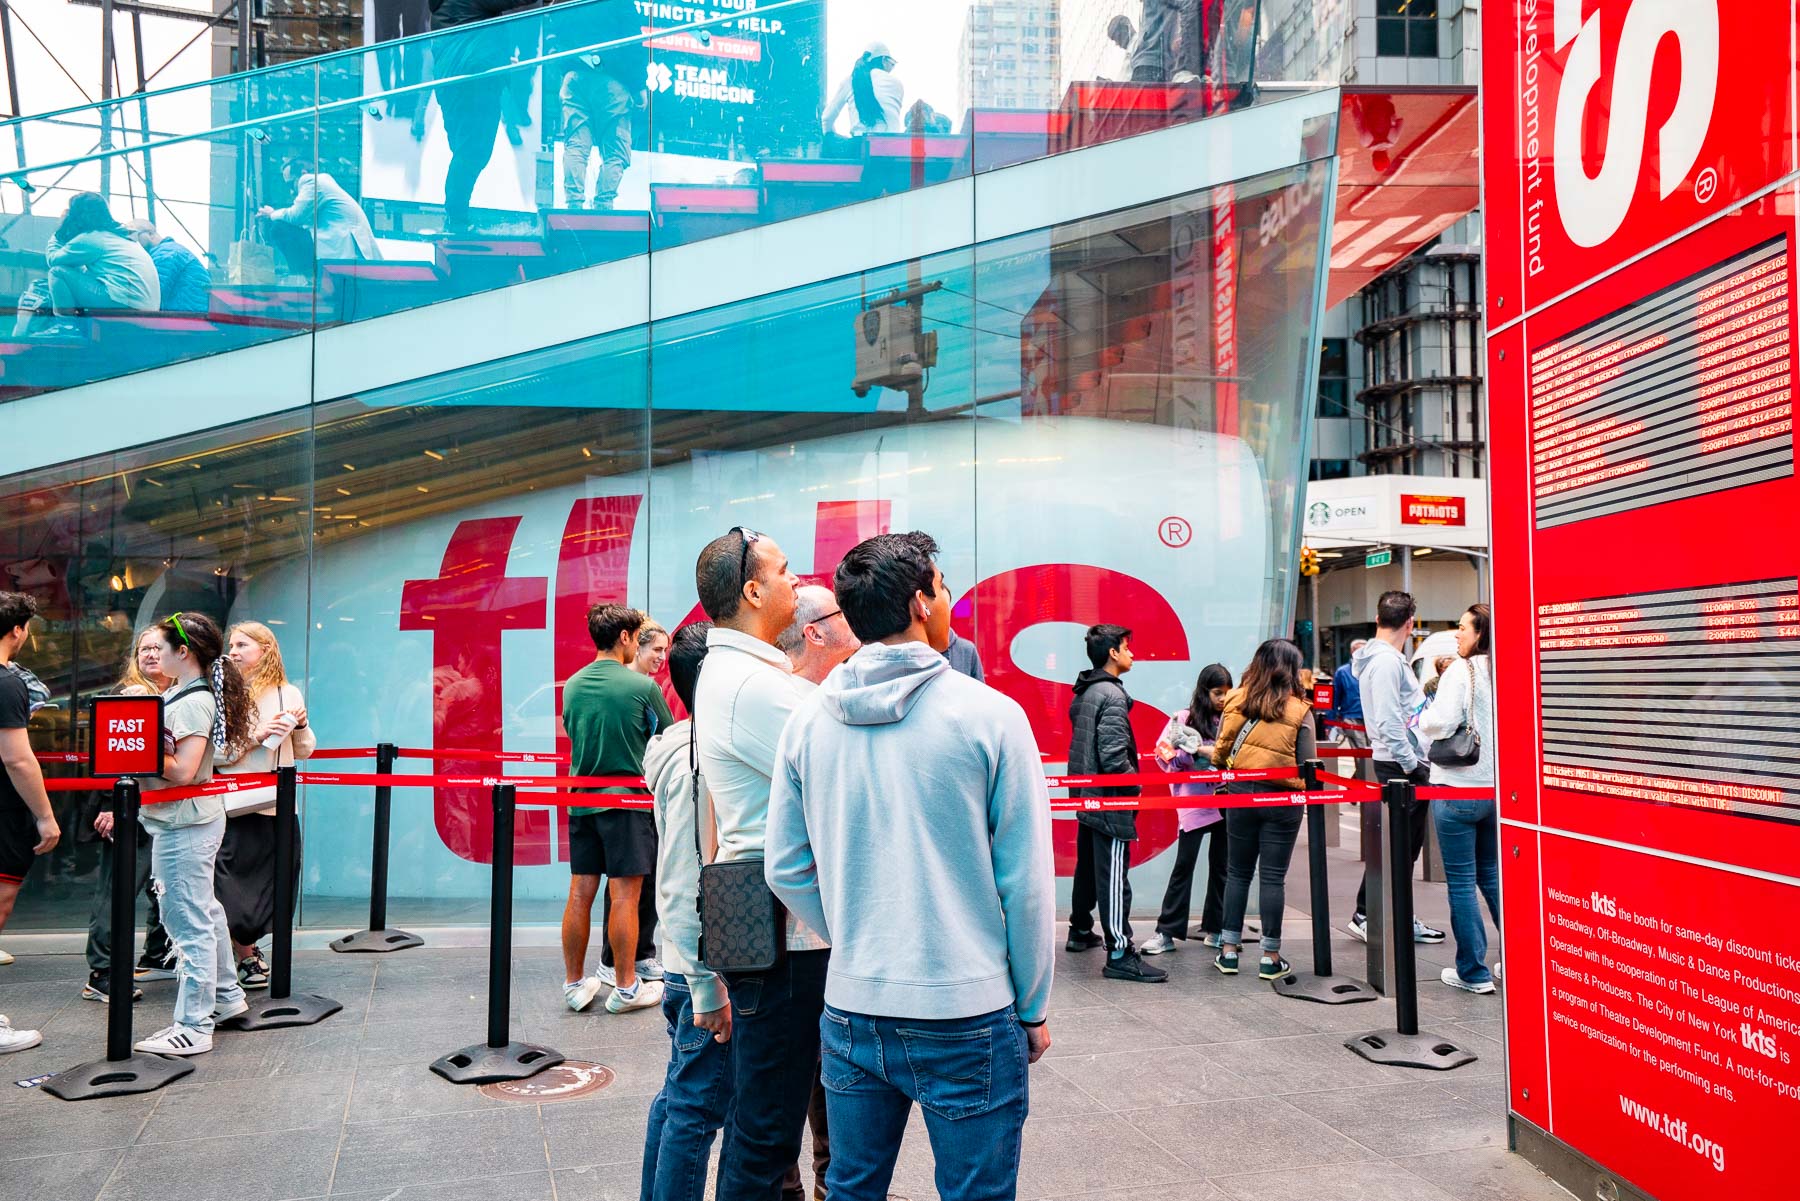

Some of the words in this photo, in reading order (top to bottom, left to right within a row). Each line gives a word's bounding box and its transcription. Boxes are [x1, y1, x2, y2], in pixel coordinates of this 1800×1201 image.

[738, 16, 785, 35] HELP.
[717, 42, 756, 56] TODAY
[674, 64, 728, 86] TEAM
[674, 80, 755, 105] RUBICON
[1523, 0, 1541, 193] evelopment
[1528, 199, 1544, 277] fund
[1336, 507, 1366, 517] OPEN
[1409, 504, 1458, 518] PATRIOTS
[1740, 601, 1756, 610] 50%
[1740, 616, 1756, 624] 50%
[1740, 630, 1756, 638] 50%
[108, 719, 144, 733] FAST
[108, 737, 146, 752] PASS
[1702, 783, 1714, 794] the
[1719, 785, 1738, 797] TKTS
[1742, 787, 1781, 802] DISCOUNT
[1548, 887, 1580, 906] Welcome
[1582, 898, 1590, 910] to
[1591, 892, 1616, 917] tkts
[1619, 908, 1632, 922] the
[1634, 912, 1658, 930] booth
[1660, 919, 1673, 934] for
[1676, 926, 1723, 952] same-day
[1726, 939, 1772, 964] discount
[1775, 952, 1800, 973] ticke
[1549, 912, 1556, 924] to
[1558, 914, 1596, 939] Broadway,
[1598, 927, 1656, 958] Off-Broadway,
[1658, 946, 1685, 966] Music
[1688, 955, 1695, 969] &
[1698, 958, 1730, 981] Dance
[1734, 970, 1800, 1005] Productions
[1550, 936, 1582, 957] Operated
[1584, 949, 1600, 963] with
[1602, 955, 1614, 968] the
[1616, 960, 1666, 987] cooperation
[1669, 979, 1678, 991] of
[1680, 981, 1698, 999] The
[1702, 989, 1739, 1014] League
[1743, 1005, 1754, 1018] of
[1551, 960, 1582, 982] Theaters
[1584, 972, 1590, 984] &
[1592, 976, 1634, 1002] Producers.
[1637, 992, 1654, 1009] The
[1656, 1000, 1674, 1021] City
[1676, 1010, 1685, 1023] of
[1688, 1012, 1710, 1032] New
[1713, 1022, 1738, 1044] York
[1740, 1022, 1777, 1059] tkts
[1780, 1048, 1790, 1064] is
[1552, 987, 1557, 996] a
[1559, 989, 1588, 1009] program
[1590, 1001, 1598, 1013] of
[1600, 1004, 1630, 1027] Theatre
[1633, 1018, 1691, 1053] Development
[1694, 1043, 1722, 1067] Fund.
[1726, 1058, 1734, 1072] A
[1737, 1063, 1800, 1101] not-for-prof
[1553, 1010, 1578, 1029] service
[1580, 1023, 1627, 1053] organization
[1630, 1043, 1640, 1056] for
[1644, 1048, 1657, 1066] the
[1660, 1060, 1710, 1093] performing
[1714, 1082, 1737, 1102] arts.
[1620, 1094, 1725, 1172] www.tdf.org
